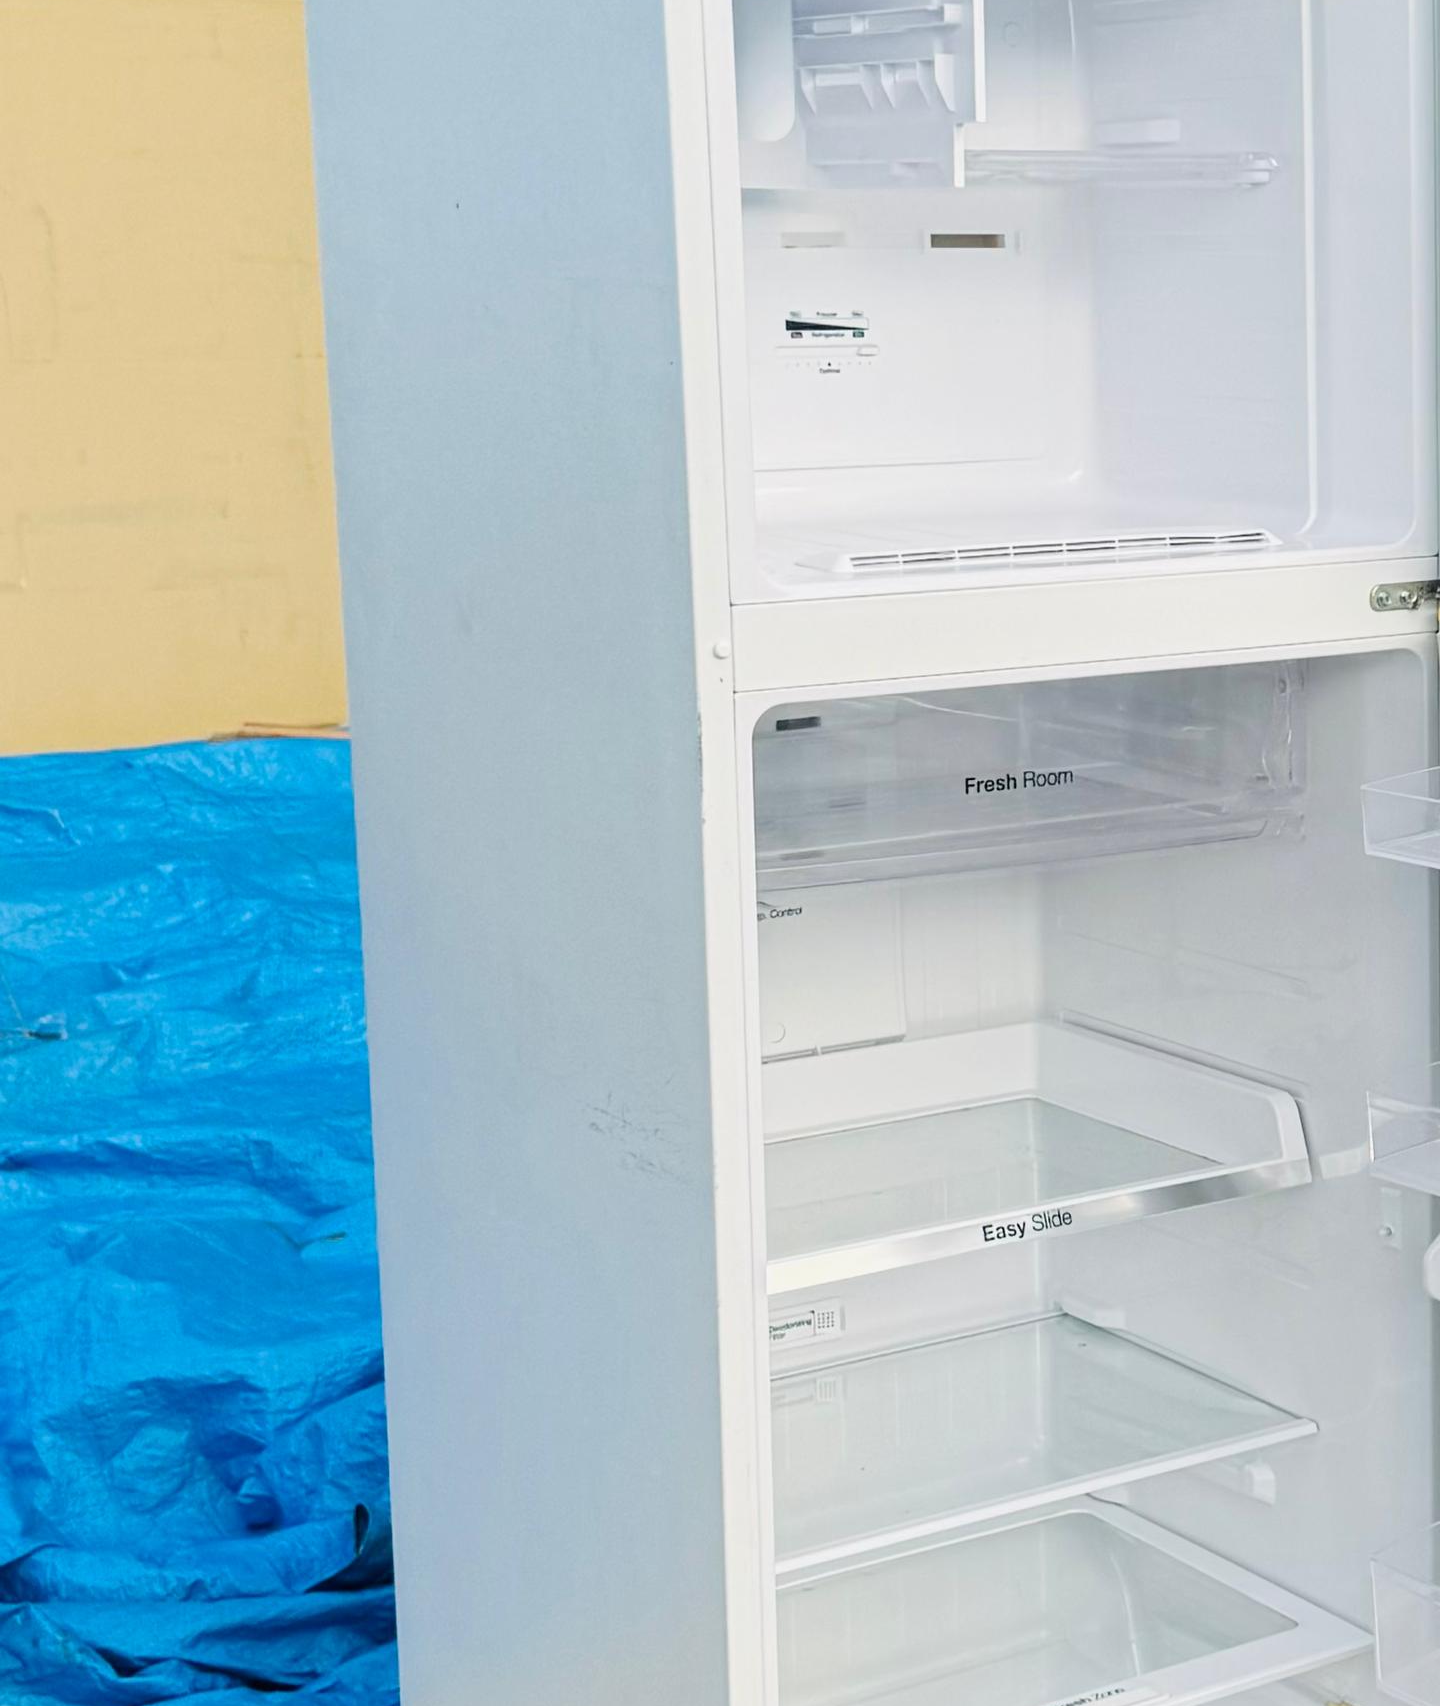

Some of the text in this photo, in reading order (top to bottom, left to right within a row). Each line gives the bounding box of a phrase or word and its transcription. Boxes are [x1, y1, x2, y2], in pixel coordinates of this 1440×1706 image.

[964, 769, 1074, 795] Fresh Room
[982, 1208, 1073, 1242] Easy Slide
